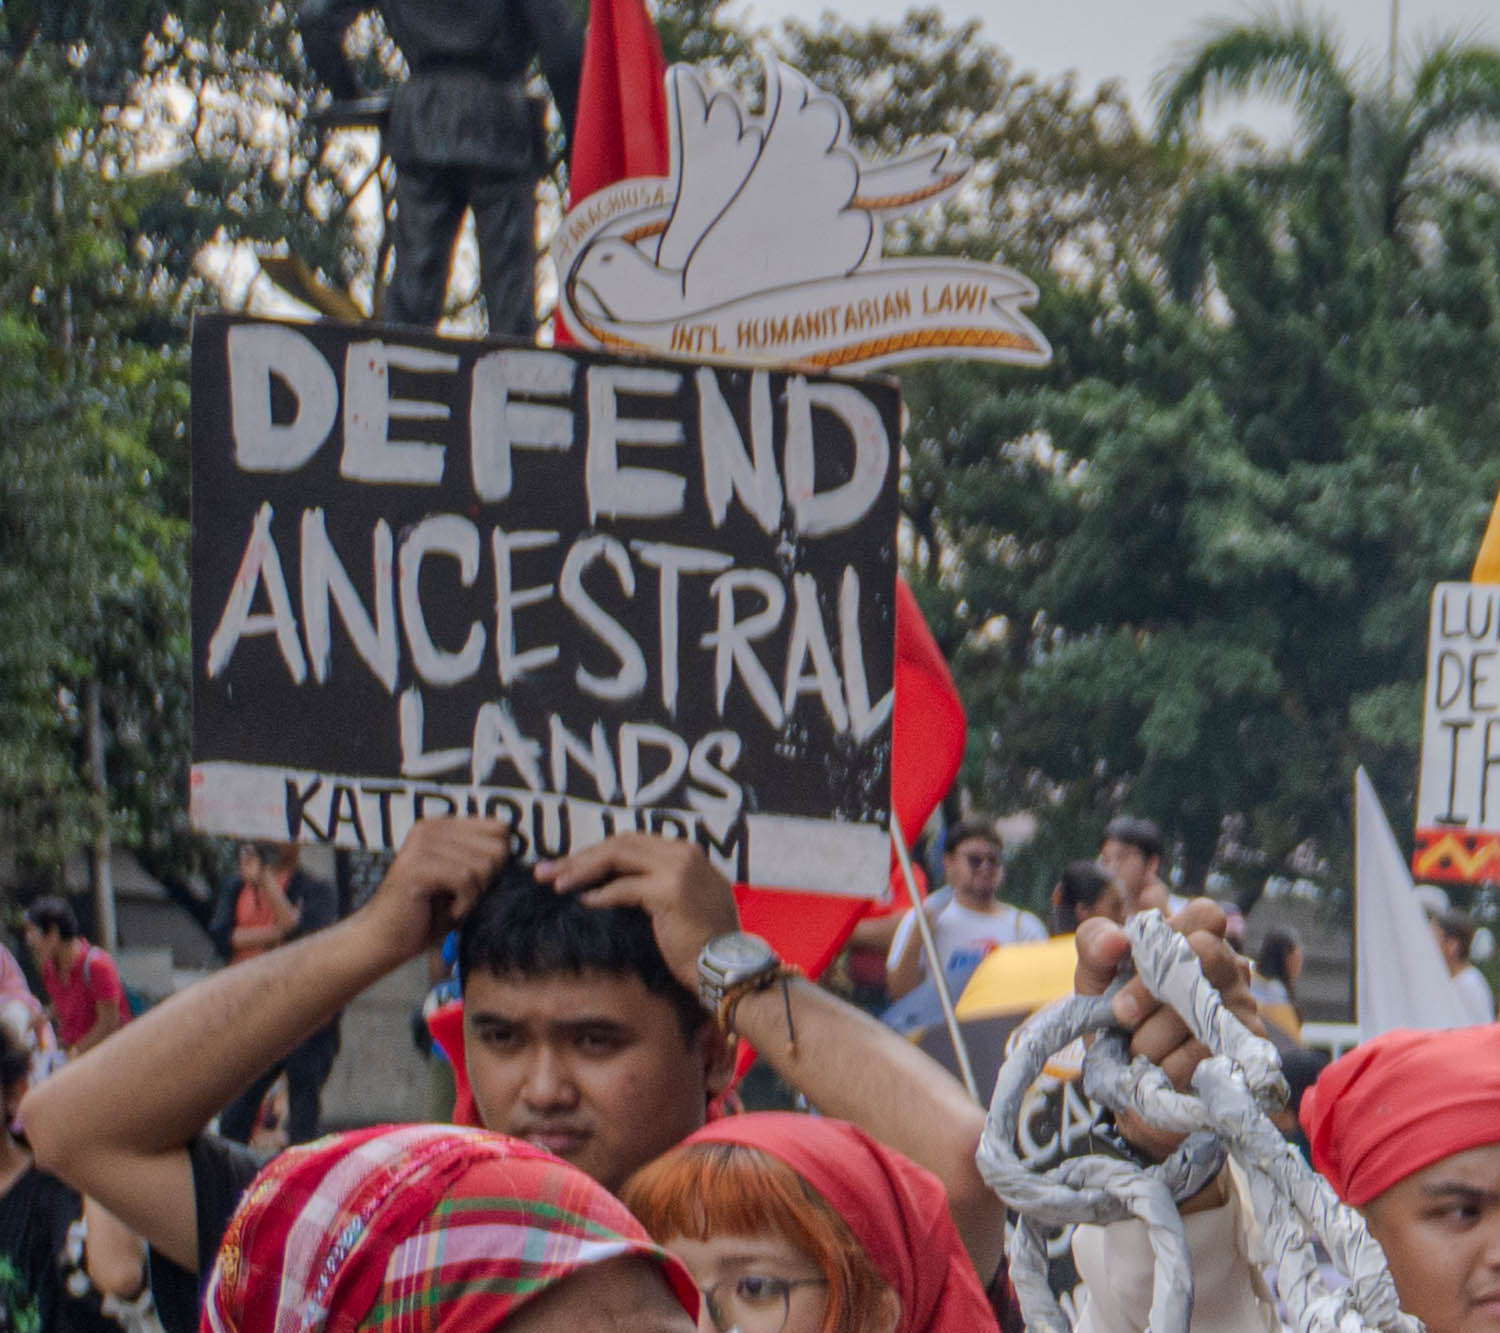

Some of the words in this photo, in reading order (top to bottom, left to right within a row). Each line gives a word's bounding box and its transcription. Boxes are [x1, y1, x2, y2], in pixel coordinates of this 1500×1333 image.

[737, 291, 913, 348] HUMANITARIAN
[228, 323, 890, 539] DEFEND
[207, 501, 893, 741] ANCESTRAL
[400, 690, 743, 815] LANDS
